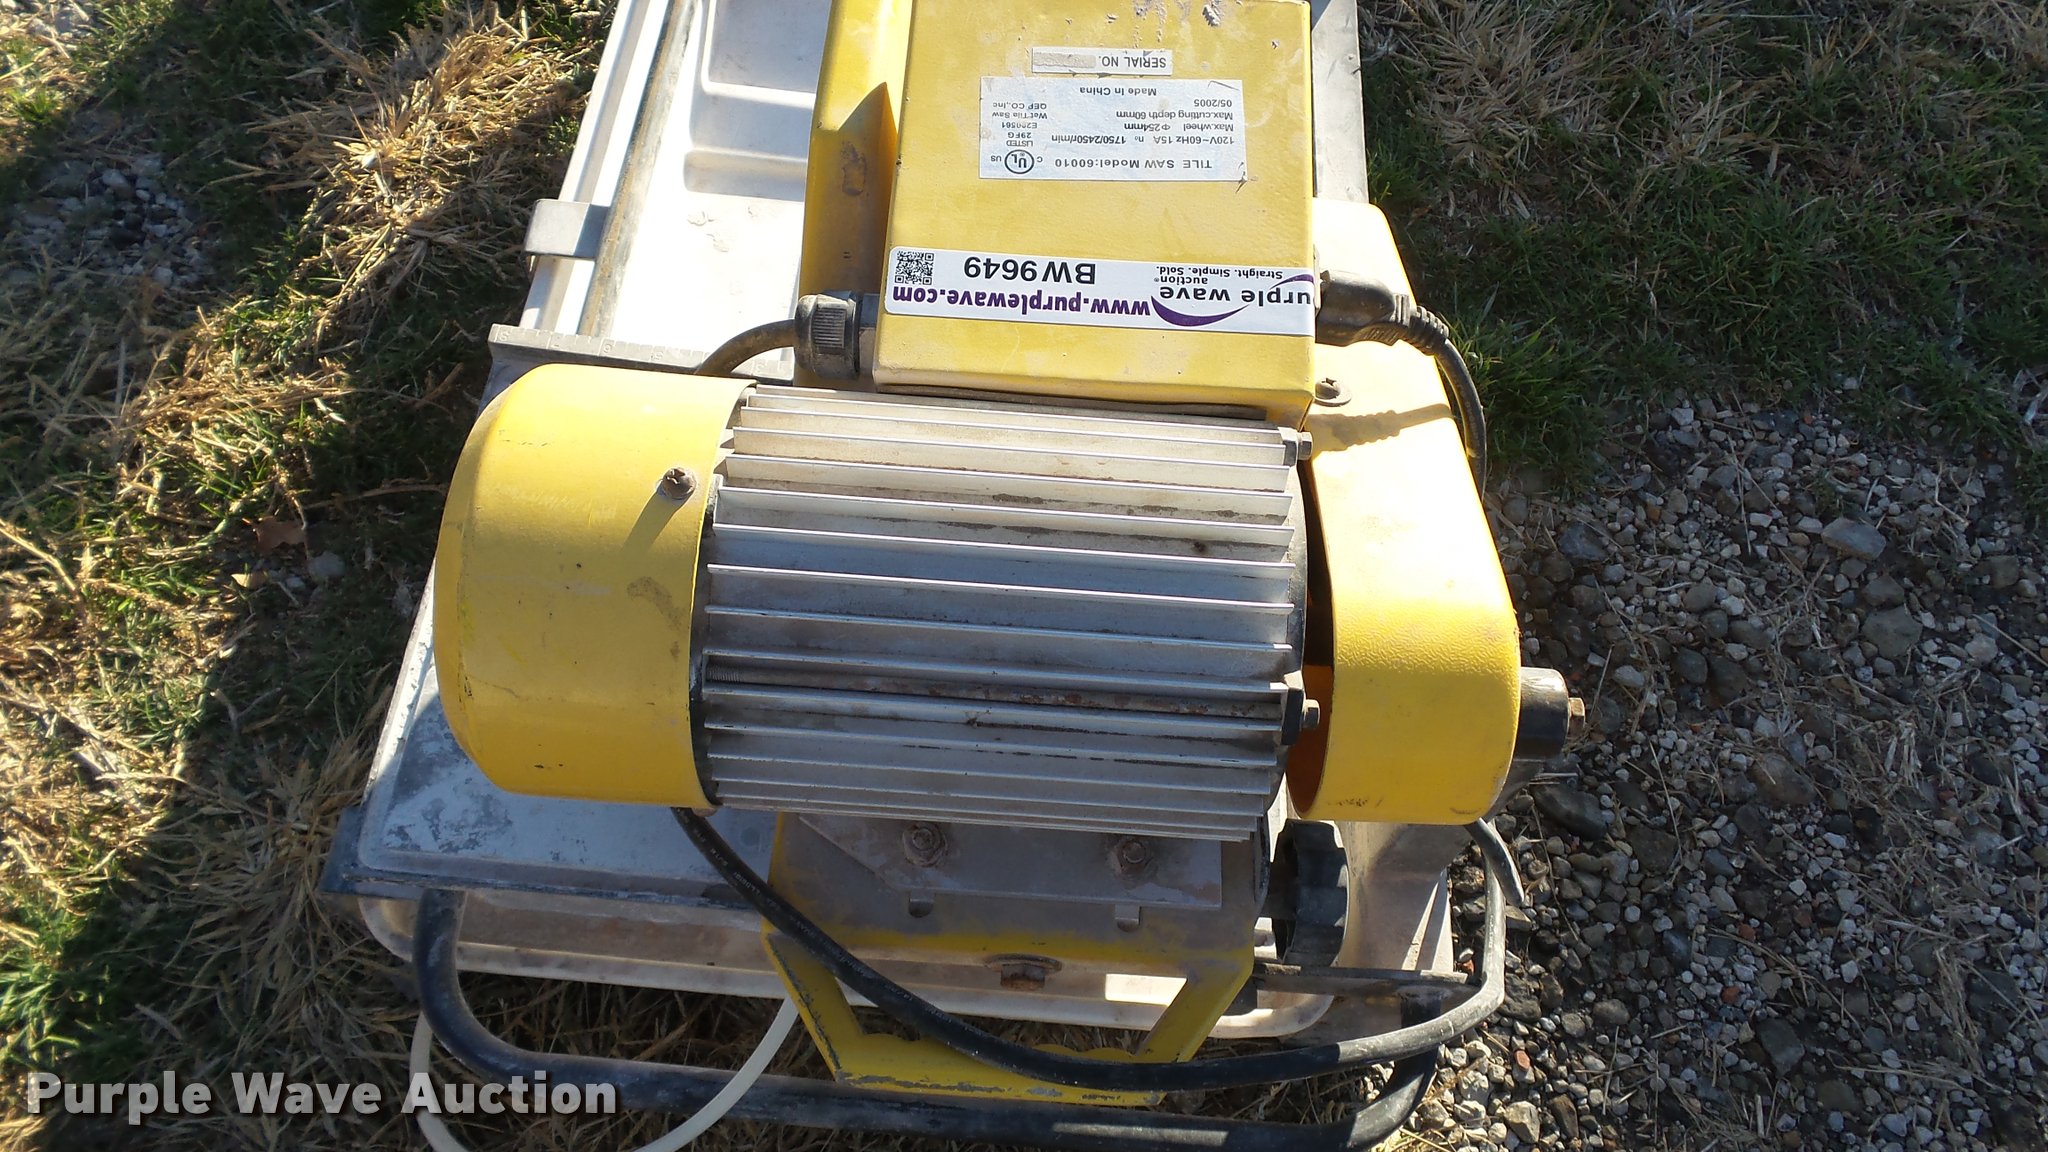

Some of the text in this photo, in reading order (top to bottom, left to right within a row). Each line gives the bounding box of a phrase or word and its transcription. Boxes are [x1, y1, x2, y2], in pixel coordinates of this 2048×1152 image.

[1098, 55, 1167, 68] SERIAL NO.
[1079, 86, 1111, 96] China
[1127, 87, 1157, 96] Made
[1193, 99, 1232, 107] 05/2005
[1116, 110, 1234, 120] Max.cutting depth 60mm
[1183, 123, 1234, 132] Max.wheel
[1051, 134, 1126, 144] 1750/2450r/min
[1152, 136, 1173, 144] 15A
[1054, 158, 1212, 168] TILE SAW Model:60010
[1155, 266, 1283, 279] Straight. Simple. Sold.
[892, 286, 1151, 316] www.purplewave.com
[1159, 286, 1311, 306] urple wave
